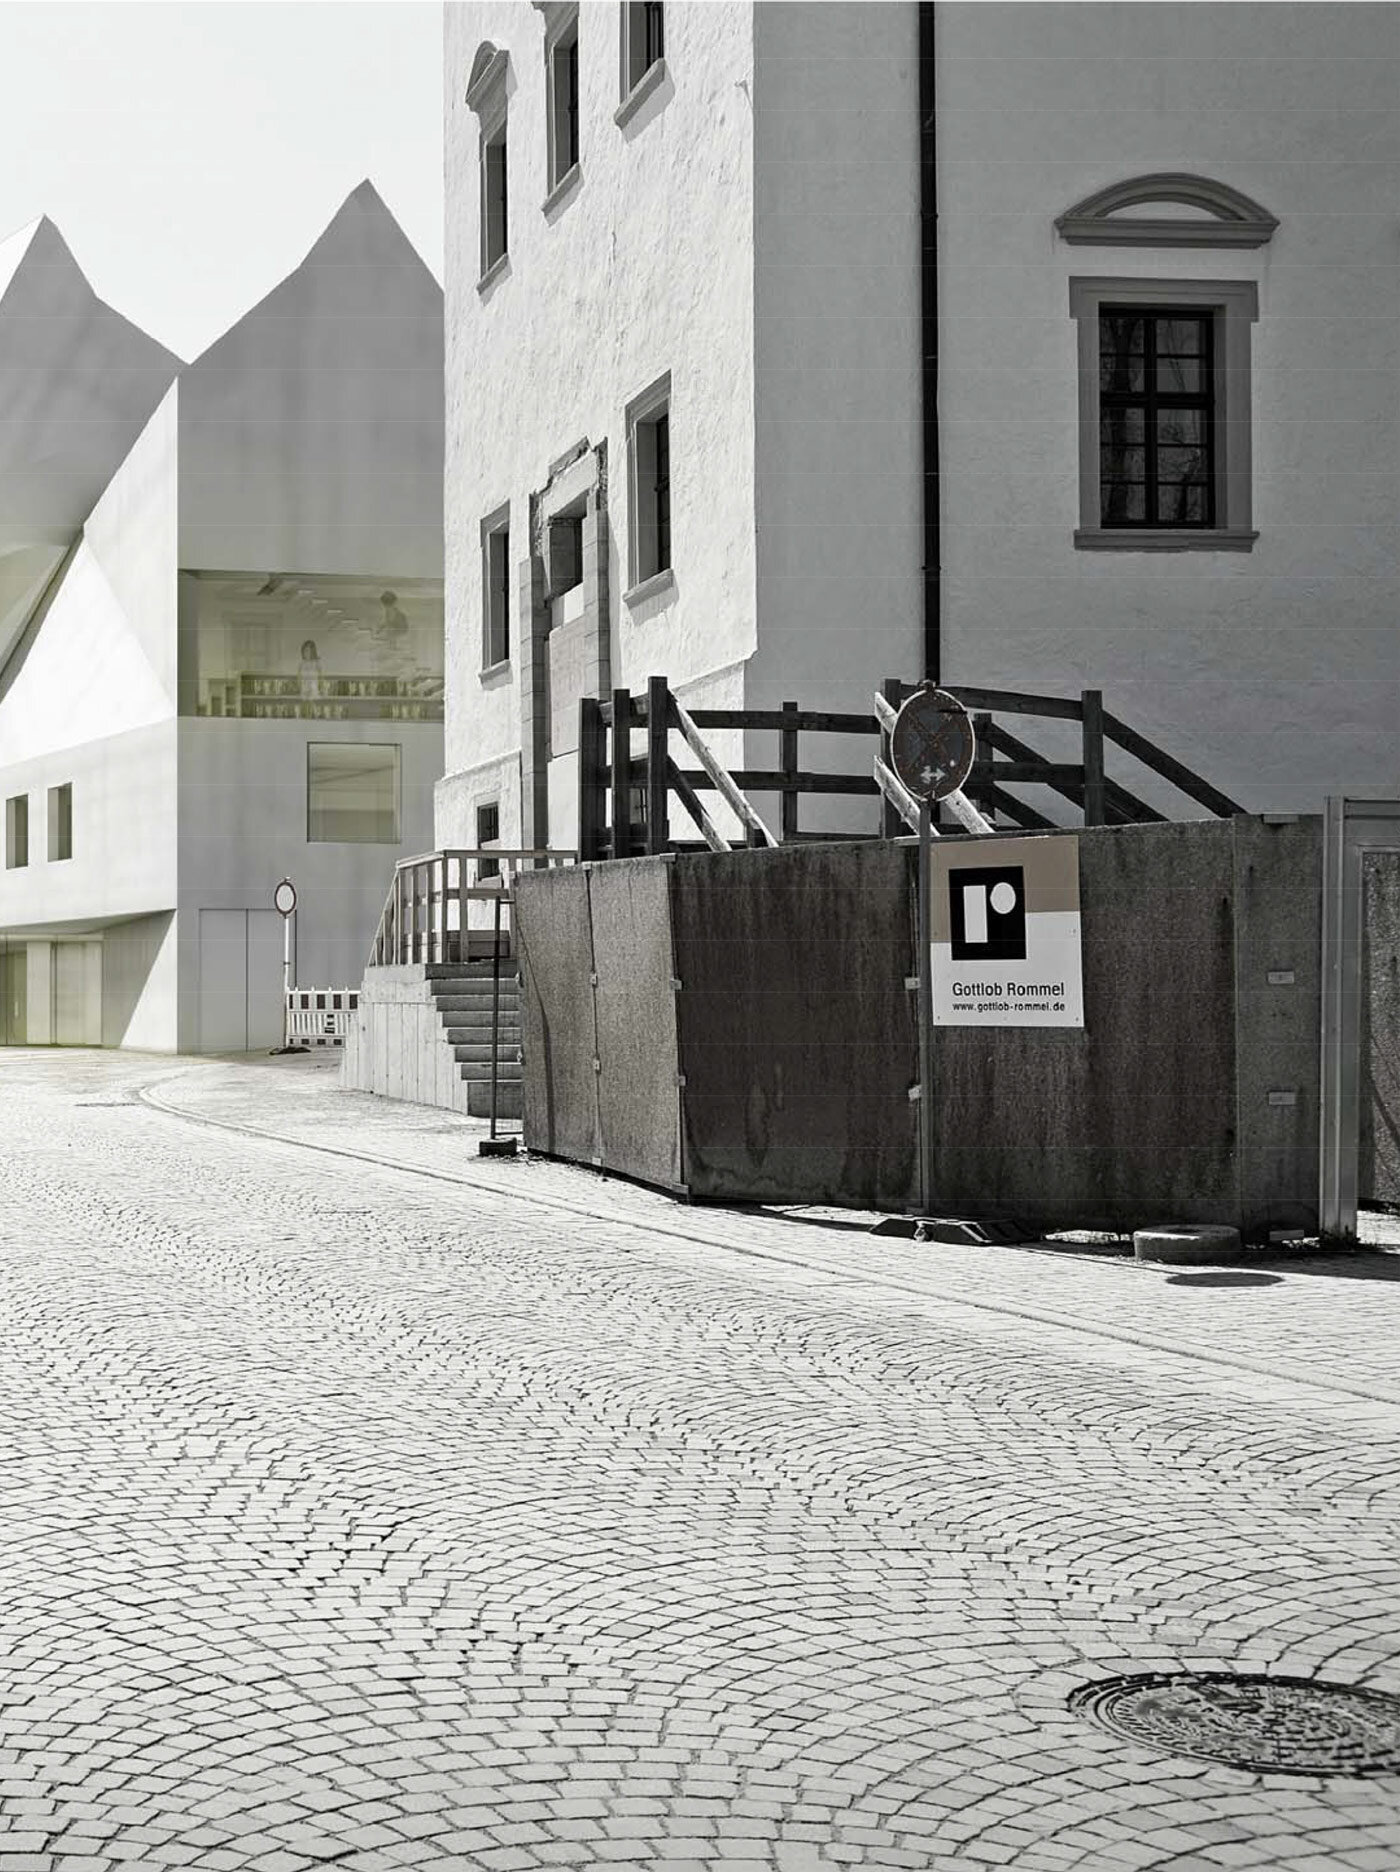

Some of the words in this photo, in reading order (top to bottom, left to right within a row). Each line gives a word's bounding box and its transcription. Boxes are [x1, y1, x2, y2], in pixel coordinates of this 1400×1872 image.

[952, 982, 1002, 996] Gottlob
[1007, 982, 1065, 996] Rommel
[952, 1002, 1065, 1013] www.gottlob-rommel.de
